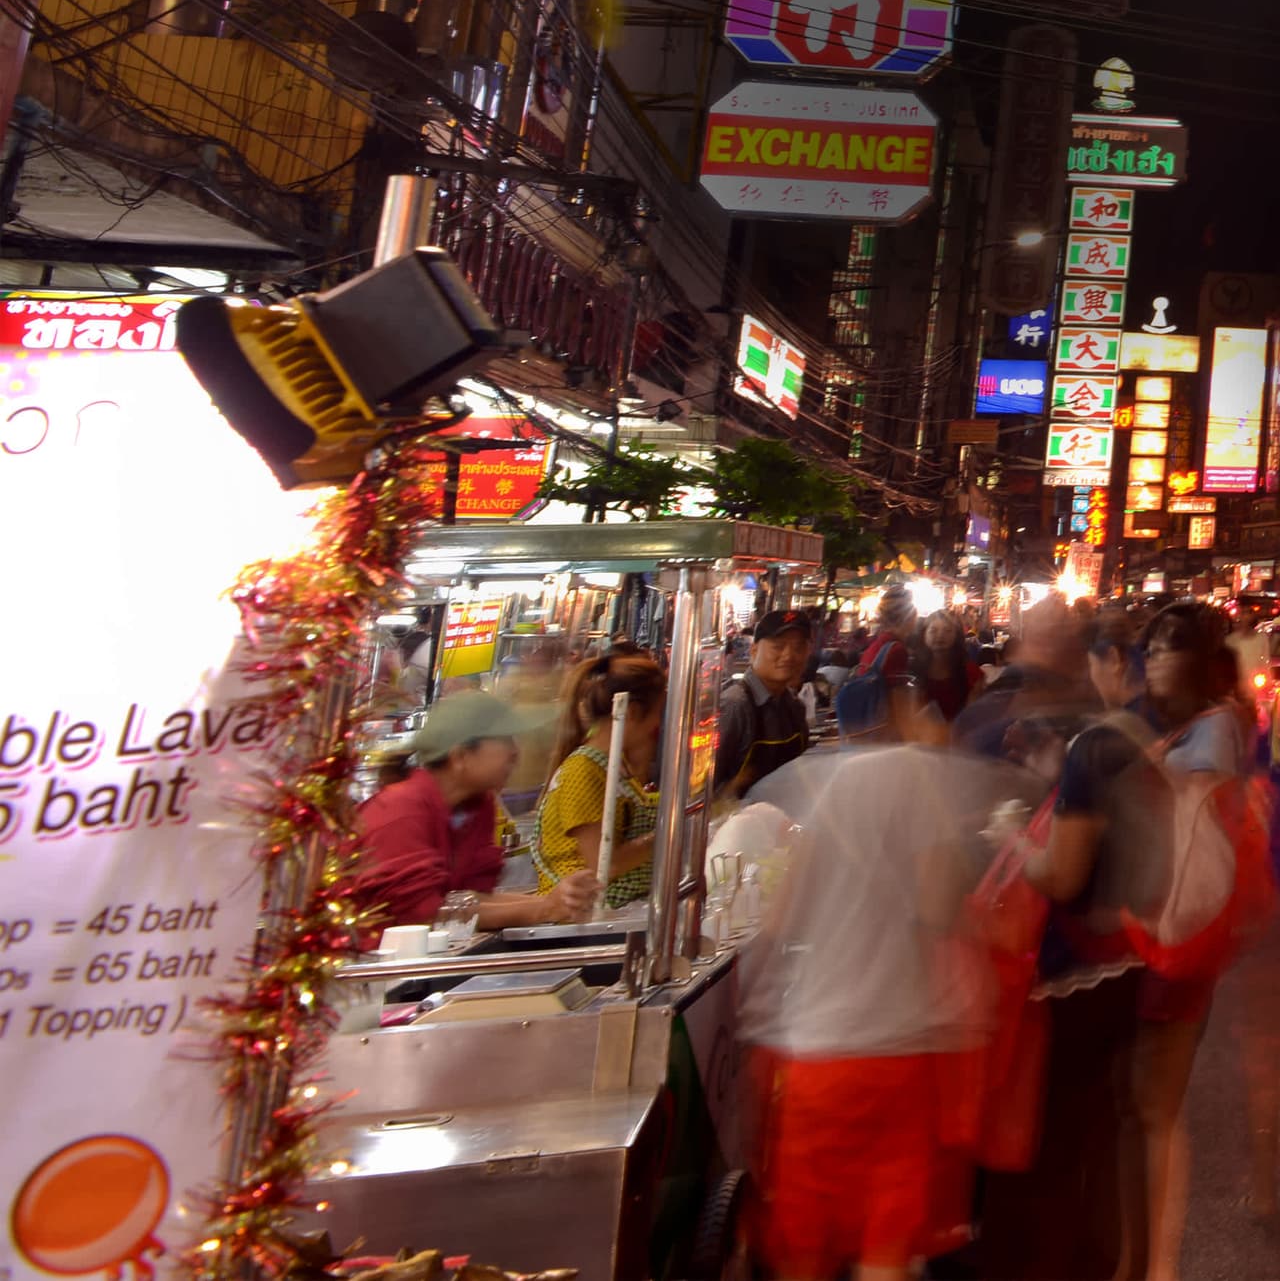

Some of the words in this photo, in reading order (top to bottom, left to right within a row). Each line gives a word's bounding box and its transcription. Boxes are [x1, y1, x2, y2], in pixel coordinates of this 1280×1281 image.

[706, 124, 929, 174] EXCHANGE
[117, 702, 268, 756] Lava
[34, 767, 189, 832] baht
[86, 904, 134, 935] 45
[139, 900, 218, 933] baht
[85, 951, 133, 984] 65
[136, 948, 216, 981] baht
